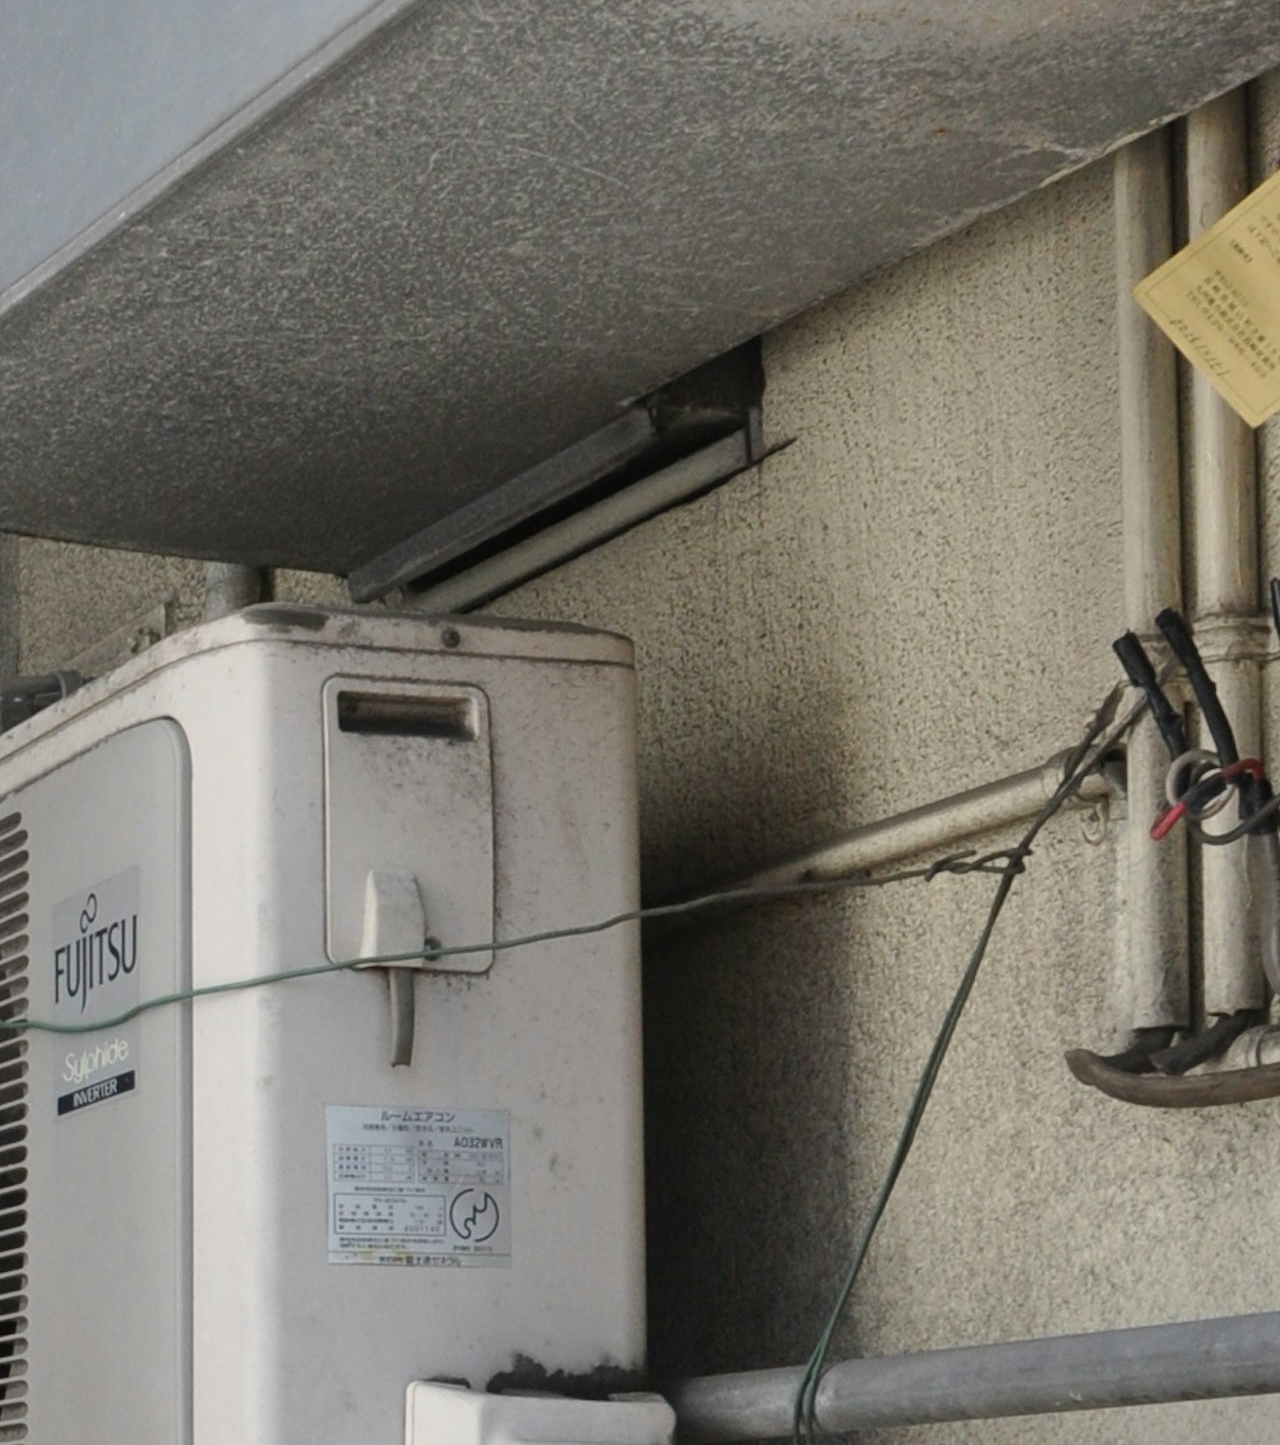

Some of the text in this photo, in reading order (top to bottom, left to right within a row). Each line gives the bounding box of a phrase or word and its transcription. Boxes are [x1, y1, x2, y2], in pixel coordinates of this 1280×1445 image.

[54, 915, 138, 1014] FUJITSU
[62, 1038, 129, 1085] Sylphide
[72, 1077, 118, 1108] INVERTER
[381, 1110, 456, 1124] ルームエアコン
